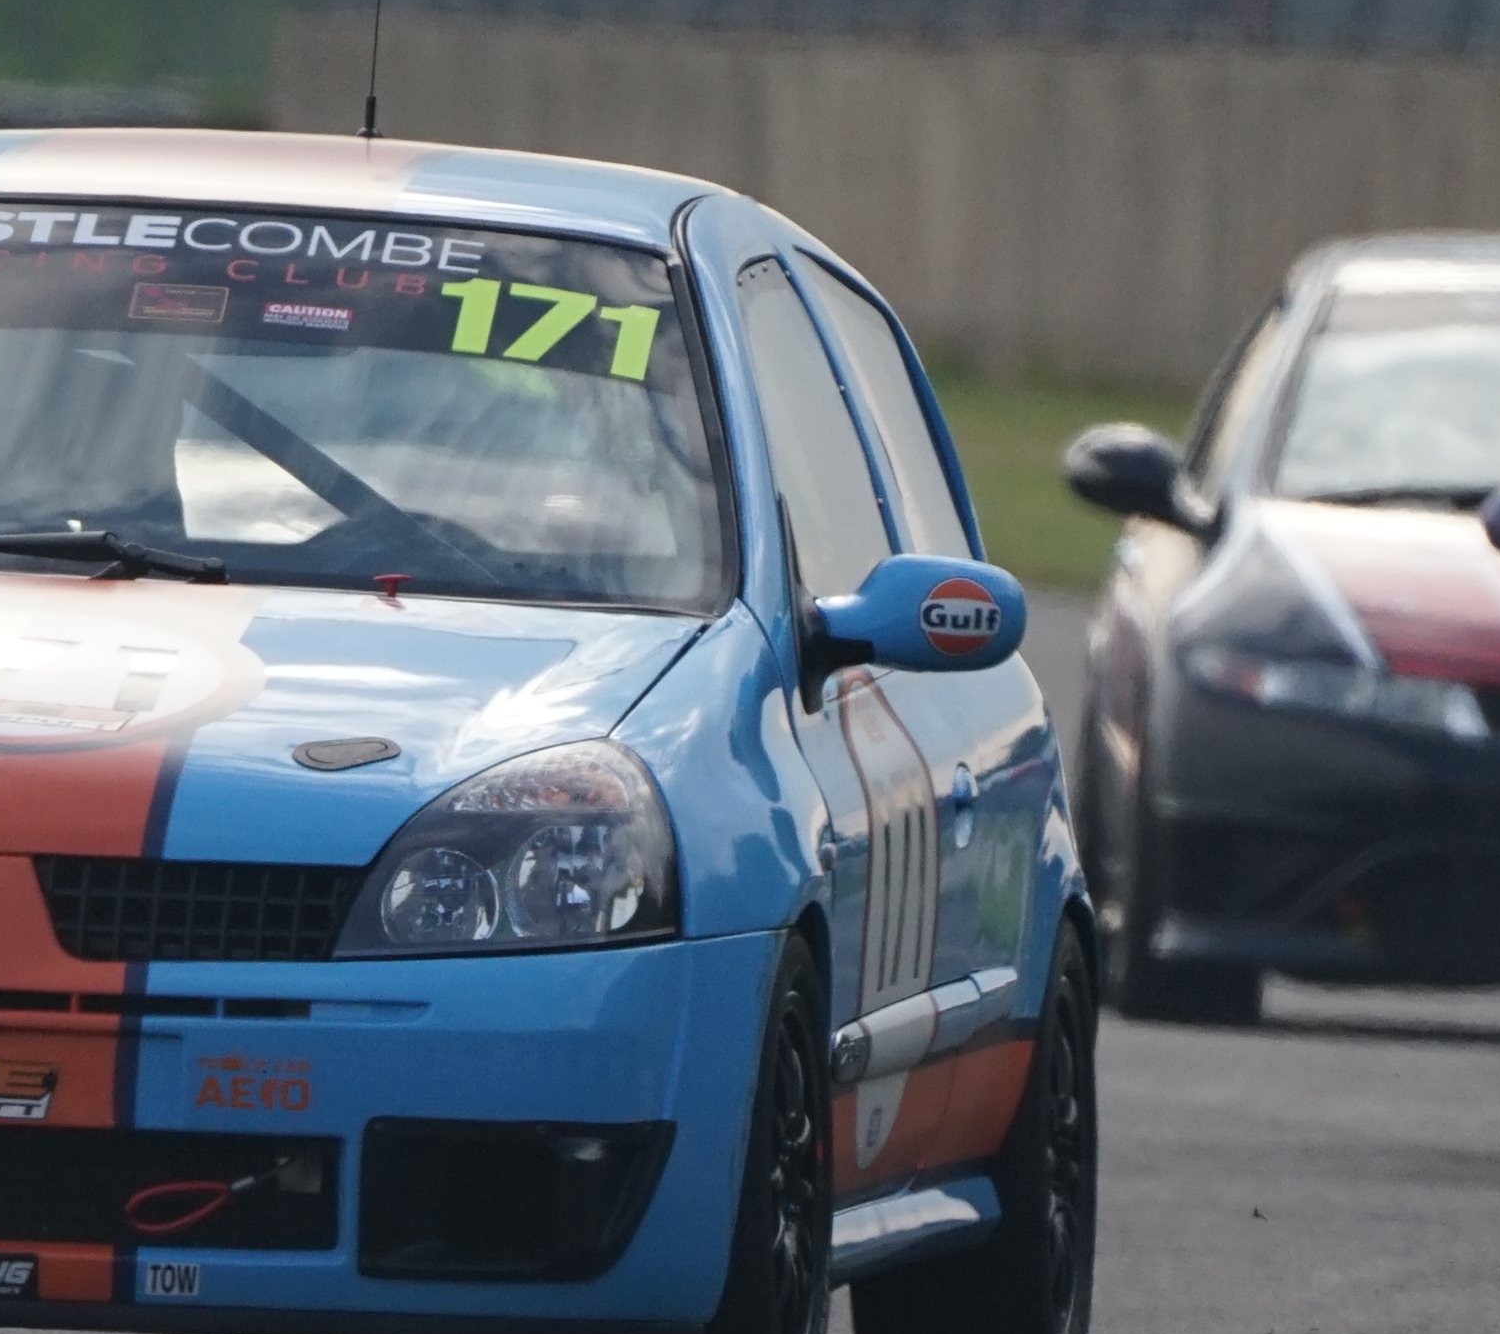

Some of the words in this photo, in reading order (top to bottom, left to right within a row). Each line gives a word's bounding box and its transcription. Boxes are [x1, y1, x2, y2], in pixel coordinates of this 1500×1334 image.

[226, 259, 428, 296] CLUB
[269, 304, 349, 319] CAUTION
[441, 277, 661, 381] 171
[922, 603, 999, 631] Gulf
[150, 1264, 197, 1294] TOW
